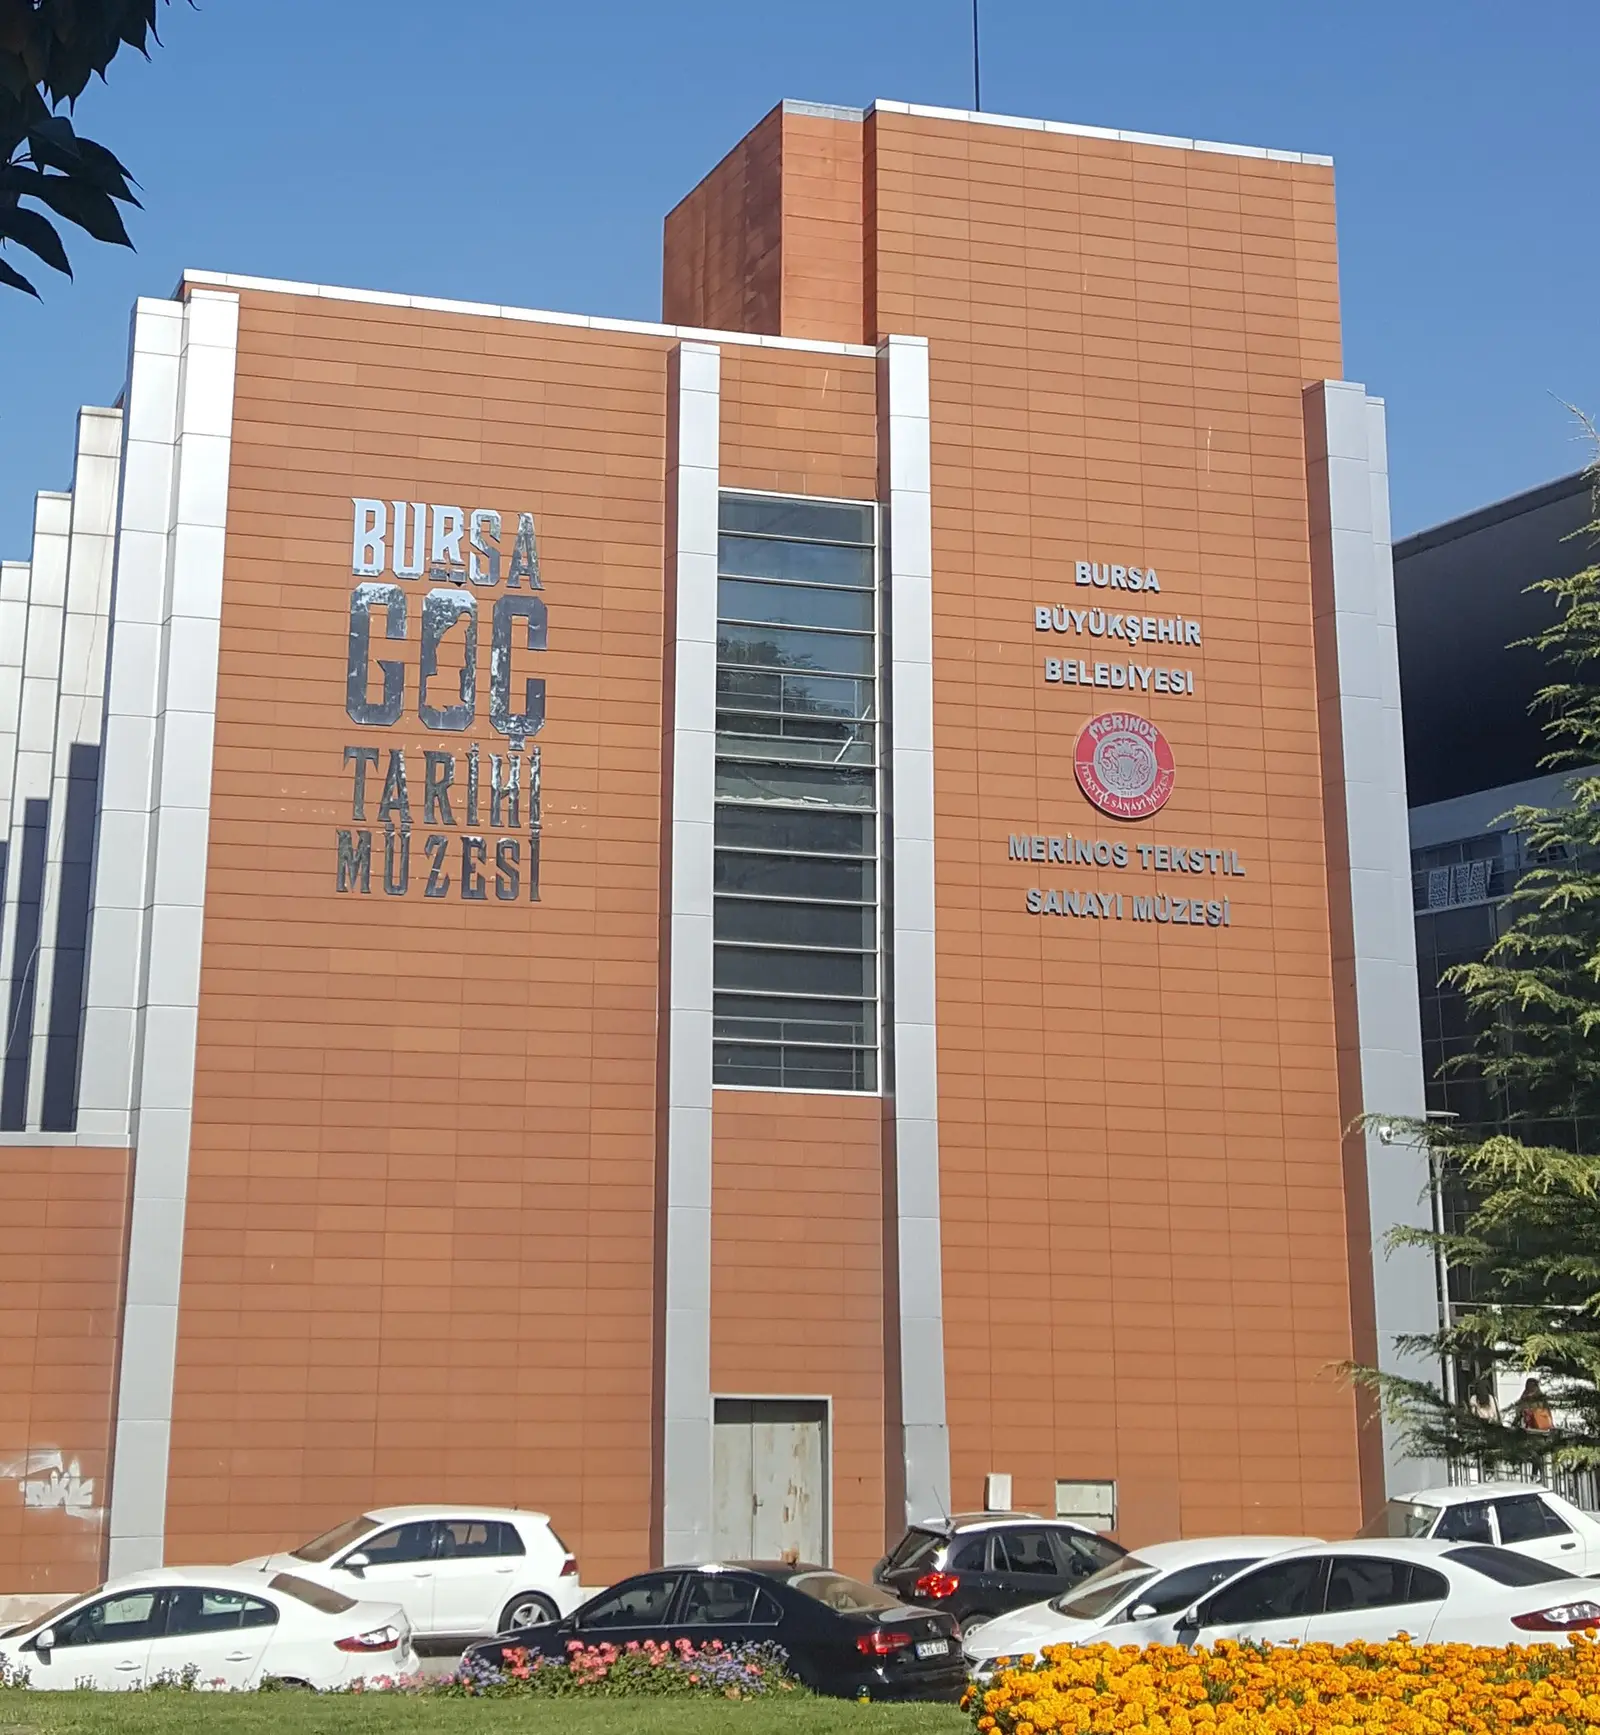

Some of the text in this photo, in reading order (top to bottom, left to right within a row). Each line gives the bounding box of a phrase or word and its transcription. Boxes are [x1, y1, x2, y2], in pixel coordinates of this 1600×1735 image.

[351, 498, 545, 590] BURSA
[1075, 561, 1160, 593] BURSA
[1035, 604, 1201, 647] BÜYÜKŞEHİR
[343, 743, 543, 829] TARİHİ
[335, 824, 542, 901] MÜZESİ
[1008, 832, 1128, 869] MERİNOS
[1132, 892, 1231, 927] MÜZESİ
